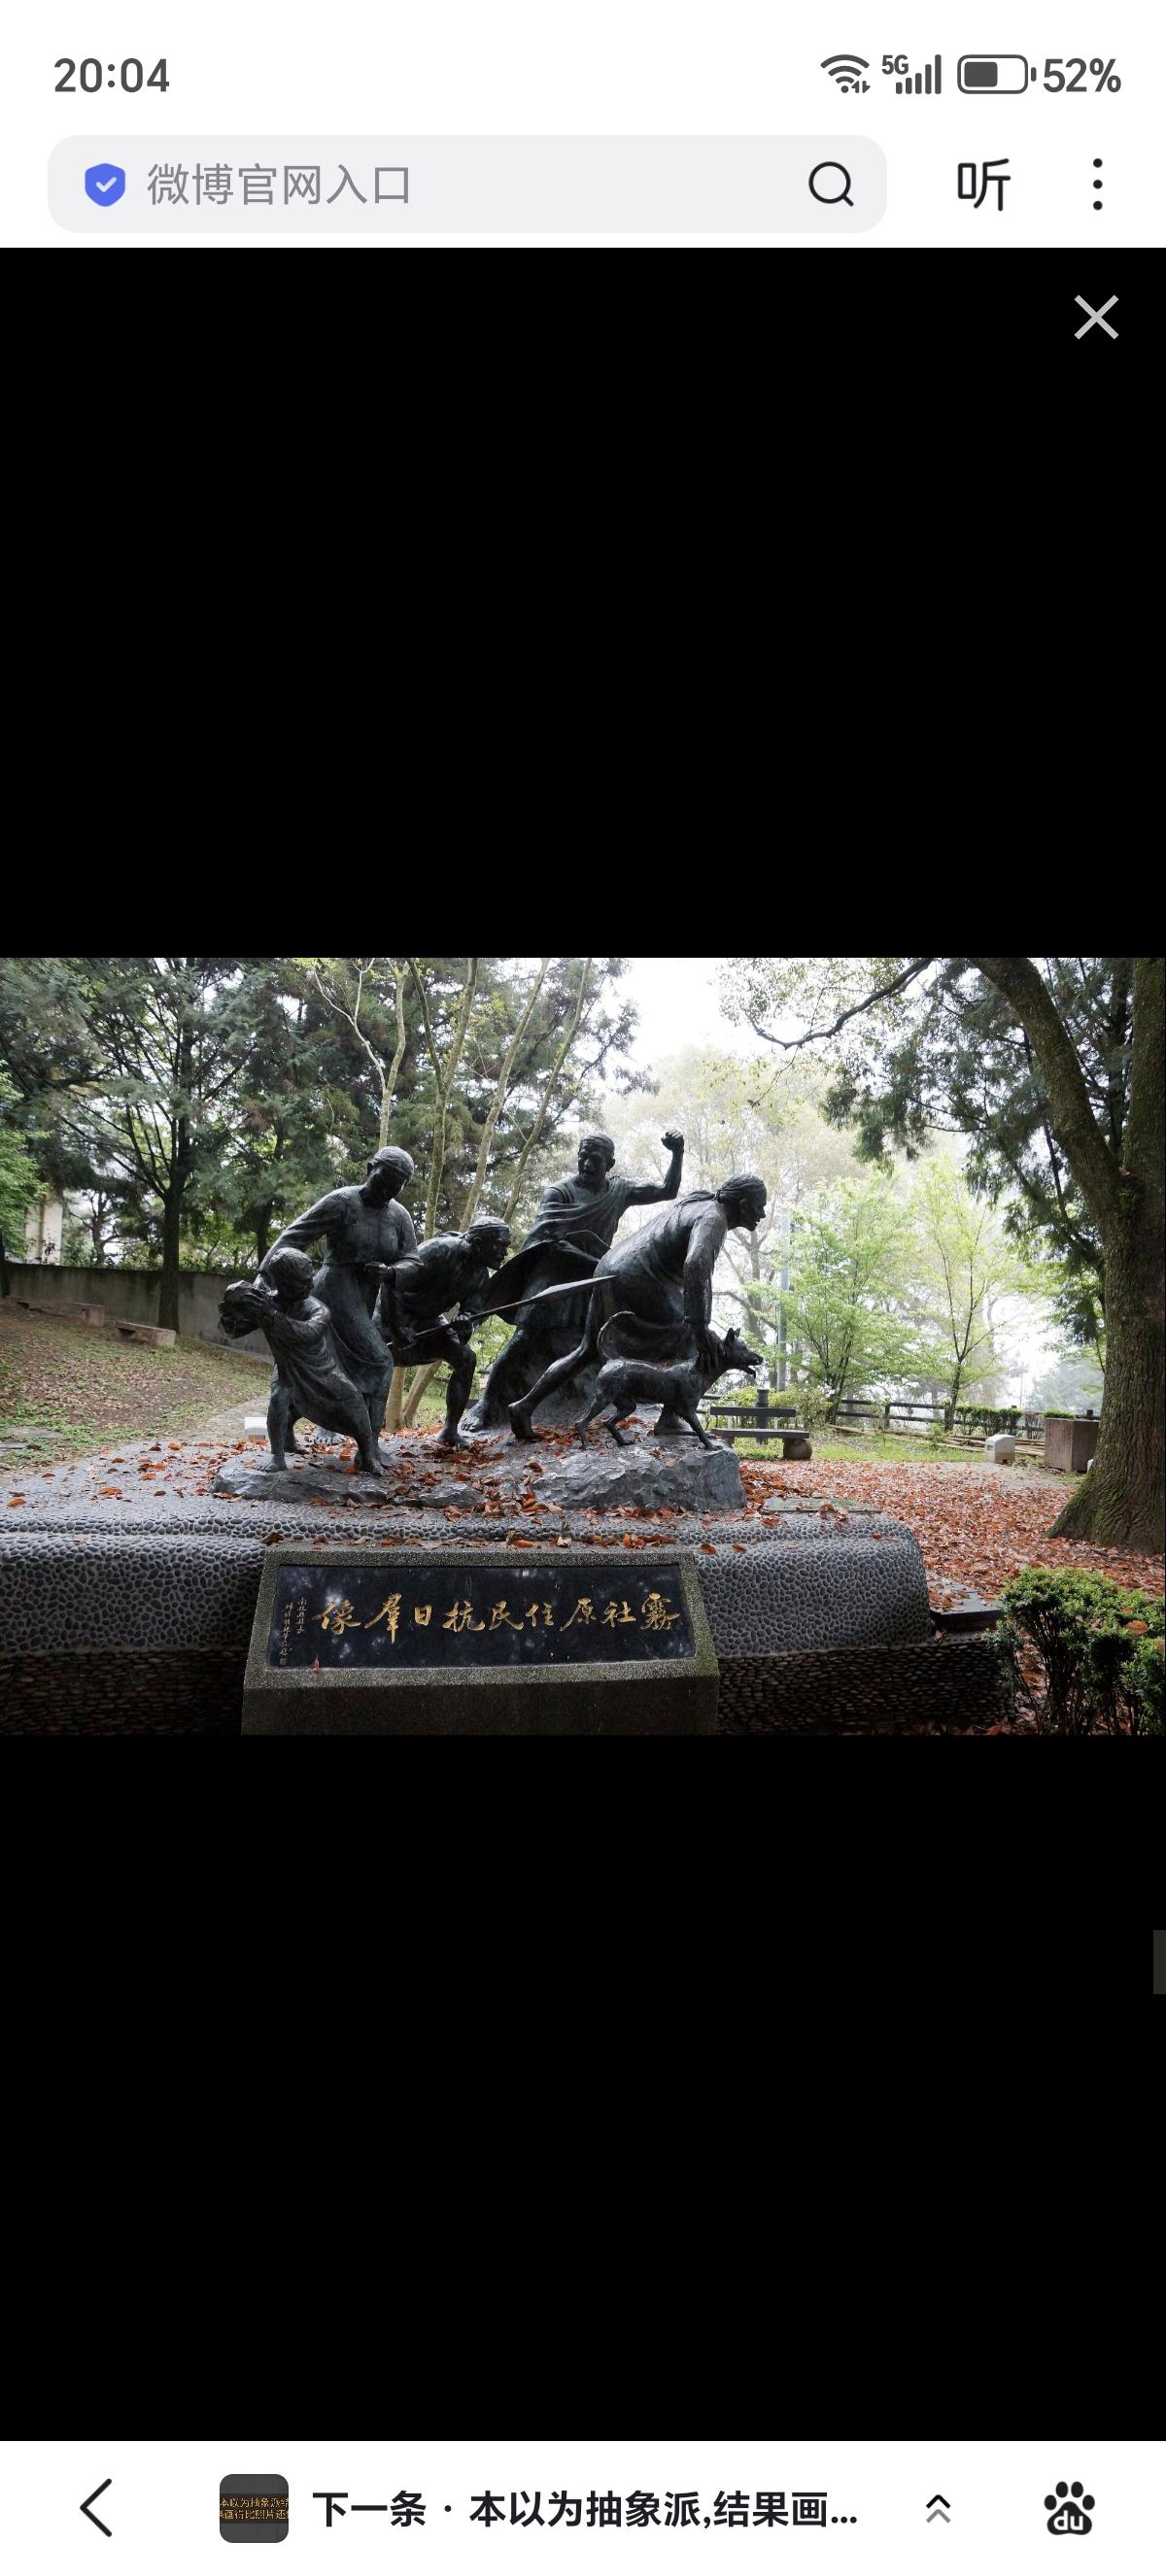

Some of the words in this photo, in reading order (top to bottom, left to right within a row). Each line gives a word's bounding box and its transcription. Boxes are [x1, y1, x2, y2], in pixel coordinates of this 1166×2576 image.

[53, 58, 170, 93] 20:04
[881, 54, 909, 76] 5G
[1043, 58, 1122, 93] 52%
[147, 162, 411, 207] 微博官网入口
[957, 158, 1012, 212] 听
[312, 2490, 427, 2527] 下一条
[1052, 2509, 1084, 2531] du
